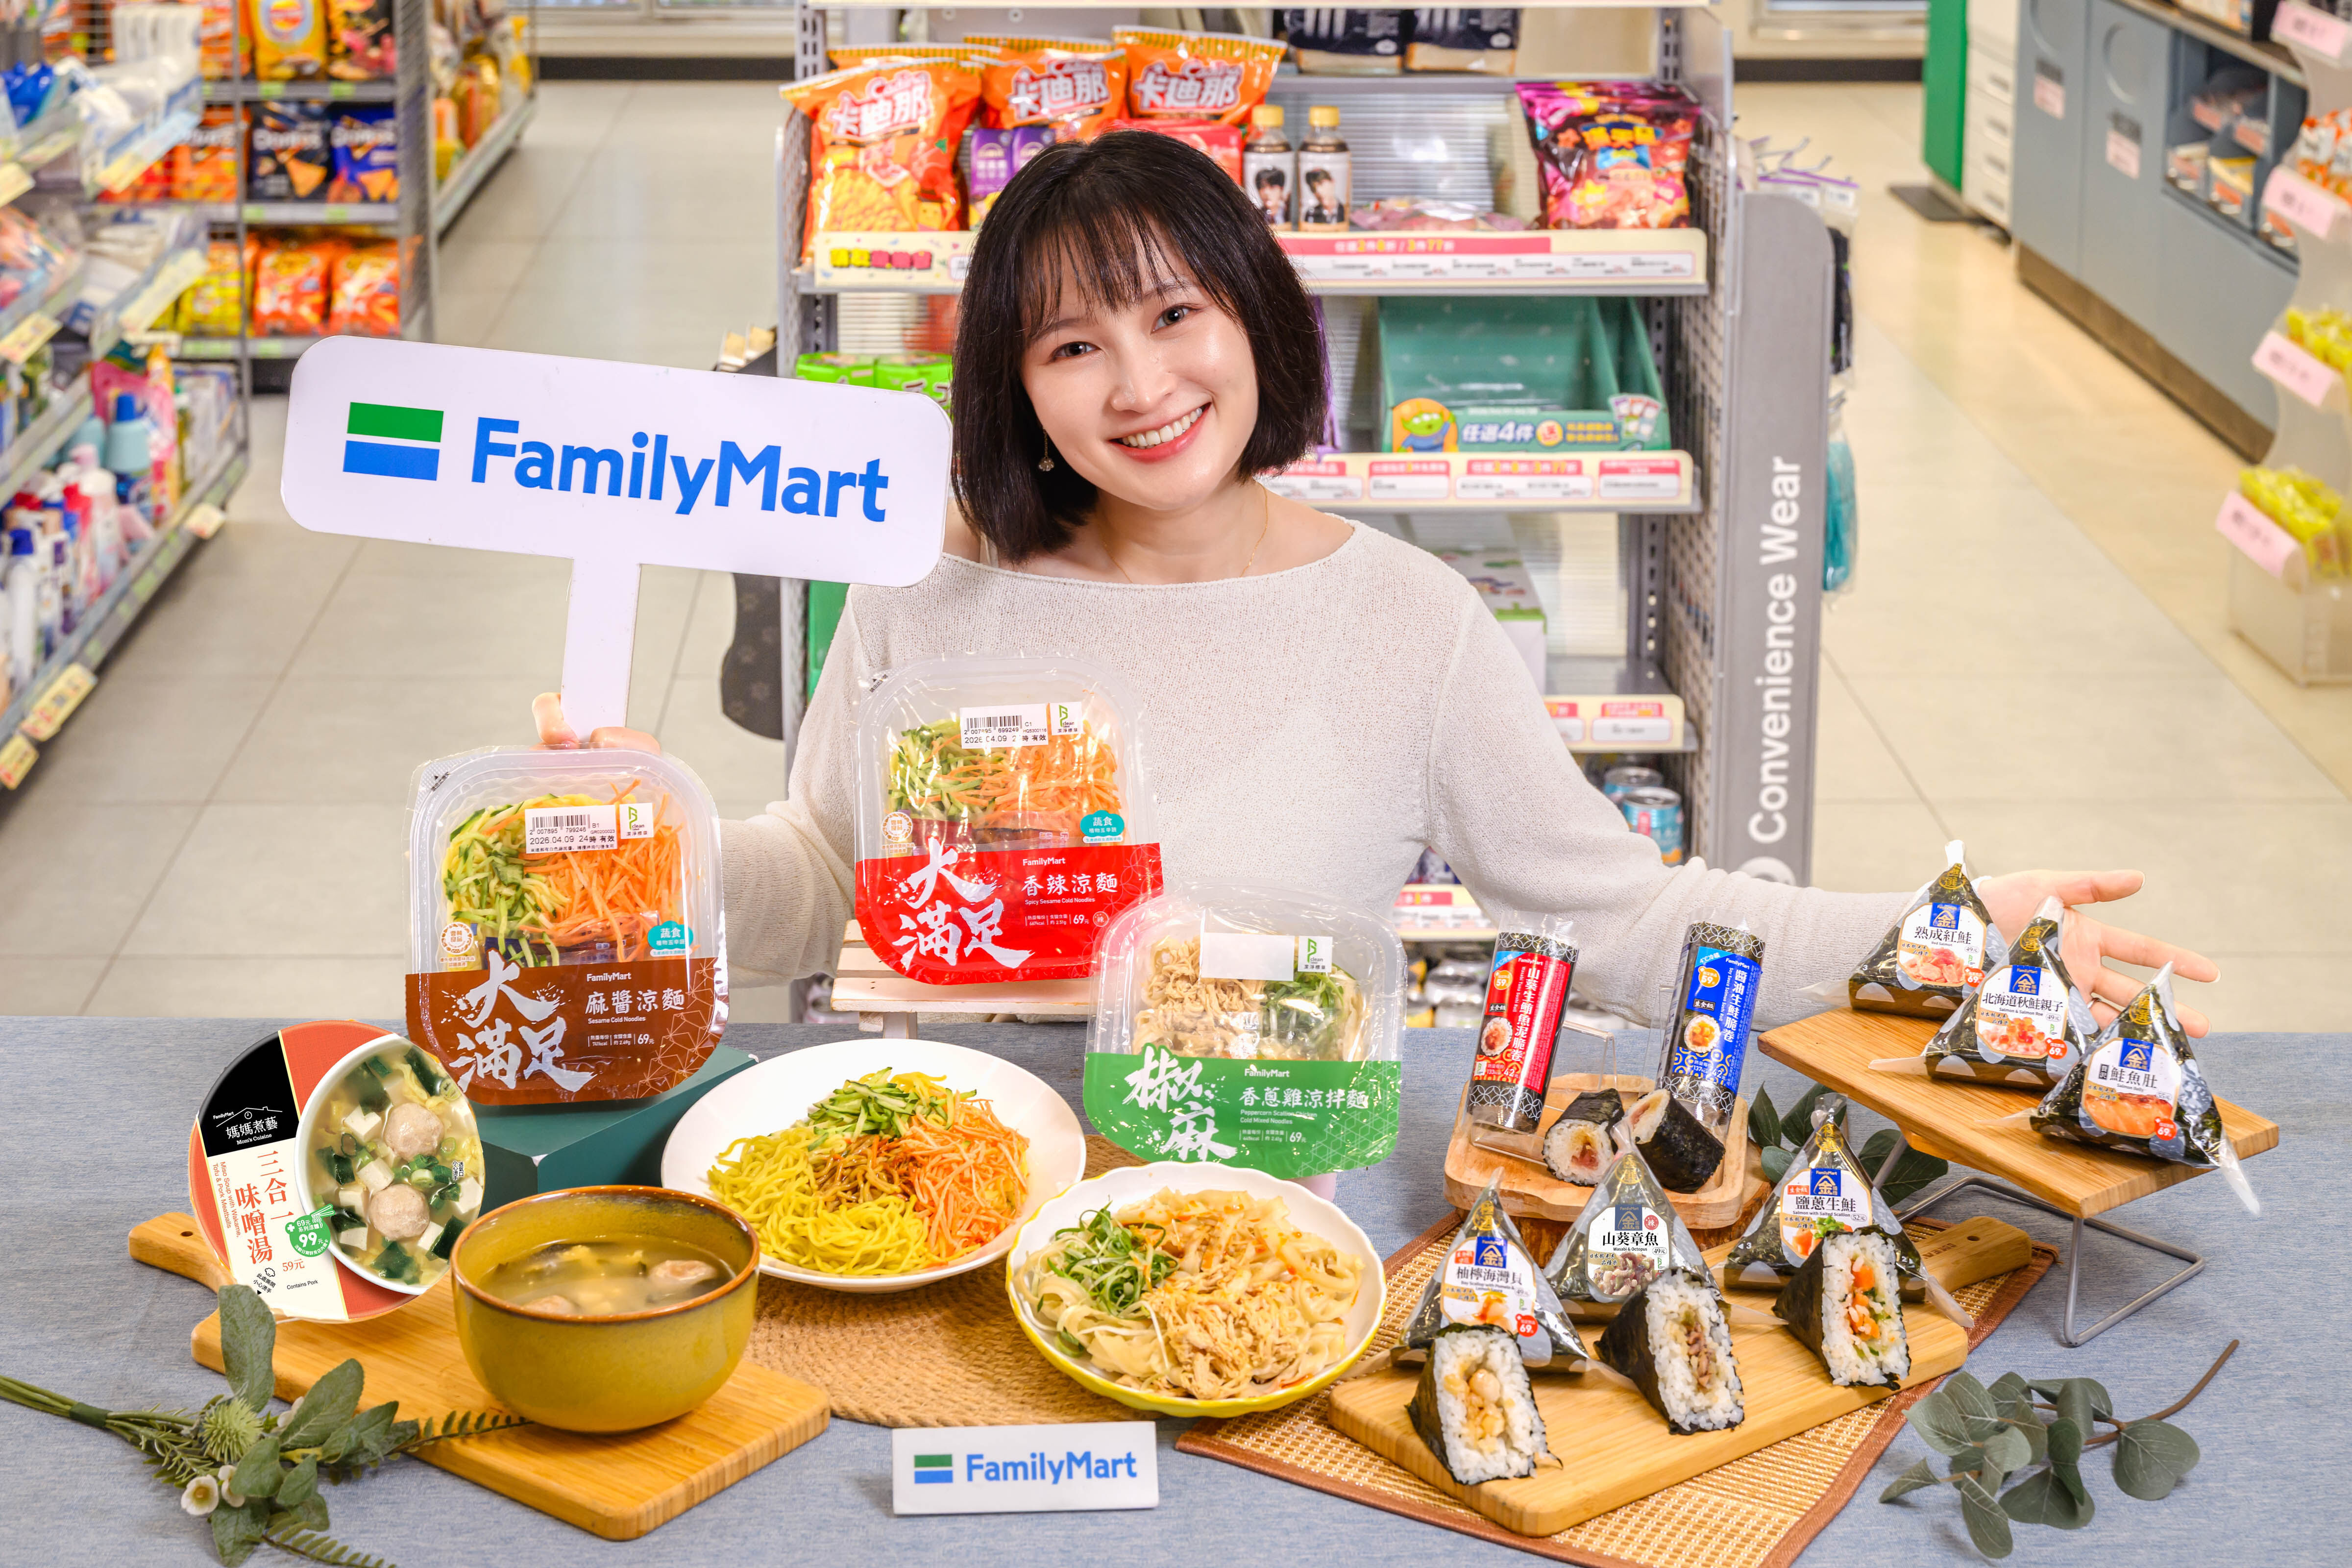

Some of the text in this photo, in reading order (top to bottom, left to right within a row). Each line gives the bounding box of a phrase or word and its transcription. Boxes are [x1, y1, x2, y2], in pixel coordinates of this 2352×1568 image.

[1010, 70, 1108, 119] 卡迪那
[1133, 64, 1236, 109] 卡迪那
[831, 85, 928, 136] 卡迪那
[471, 416, 889, 522] FamilyMart
[1748, 455, 1801, 844] Convenience Wear
[1092, 816, 1113, 827] 蔬食
[529, 835, 574, 845] 2026.04.09
[1023, 858, 1066, 866] FamilyMart
[1021, 872, 1118, 897] 香辣涼麵
[1073, 914, 1090, 924] 69元
[660, 928, 681, 938] 蔬食
[1914, 926, 1972, 945] 熟成紅鮭
[1518, 957, 1544, 966] FamilyMart
[1725, 957, 1750, 970] FamilyMart
[586, 972, 632, 982] FamilyMart
[585, 987, 685, 1015] 麻醬涼麵
[1695, 1000, 1714, 1009] 生食級
[1723, 969, 1748, 1043] 醬油生鮭脆卷
[1982, 992, 2064, 1012] 北海道秋鮭親子
[1511, 967, 1541, 1062] 山葵生鮪魚泥脆卷
[637, 1033, 655, 1045] 69元
[1244, 1068, 1290, 1078] FamilyMart
[2109, 1067, 2158, 1089] 鮭魚肚
[213, 1111, 235, 1120] FamilyMart
[1240, 1109, 1272, 1117] Peppercorn
[225, 1116, 278, 1140] 媽媽煮藝
[1289, 1131, 1307, 1143] 69元
[257, 1150, 294, 1220] 三合一
[1795, 1196, 1857, 1212] 鹽蔥生鮭
[220, 1199, 231, 1229] Meatballs
[231, 1211, 241, 1238] Wakame,
[235, 1183, 272, 1265] 味噌湯
[1602, 1231, 1659, 1246] 山葵章魚
[282, 1258, 305, 1272] 59元
[256, 1273, 276, 1288] 此處撕開
[1457, 1266, 1522, 1286] 柚檸海灣貝
[253, 1279, 272, 1294] 小心燙手
[286, 1281, 307, 1290] Contains
[966, 1450, 1138, 1485] FamilyMart
